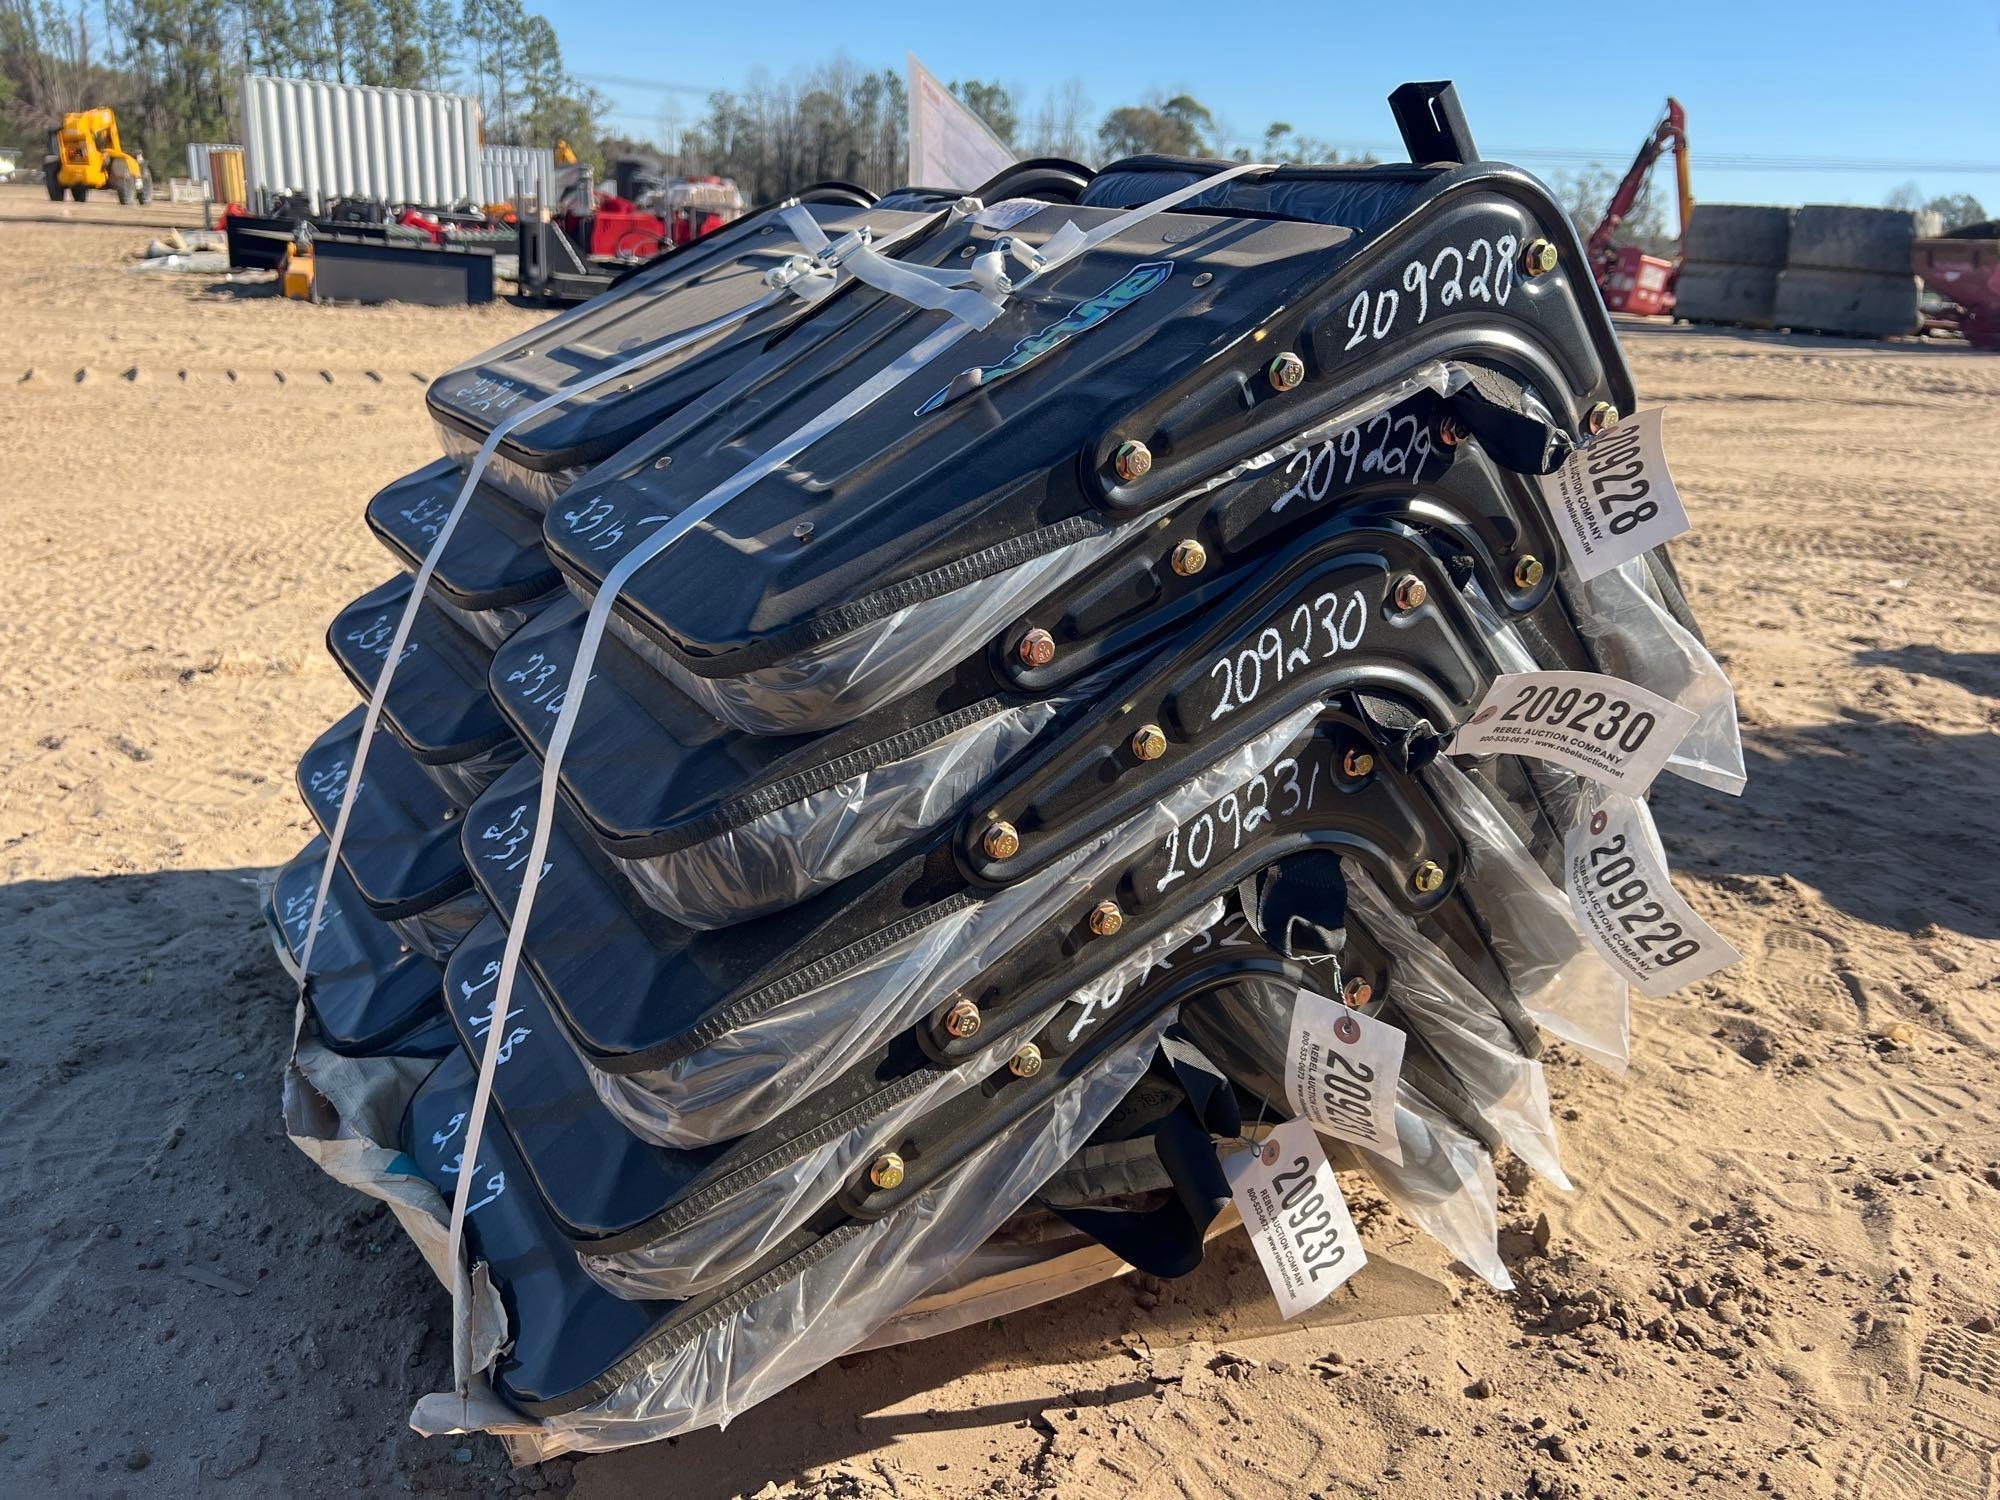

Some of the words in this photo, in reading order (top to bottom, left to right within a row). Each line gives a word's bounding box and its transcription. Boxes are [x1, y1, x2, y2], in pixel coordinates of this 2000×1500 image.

[1344, 234, 1518, 351] 209228
[1270, 411, 1432, 514] 209229
[1587, 425, 1659, 536] 209228
[1578, 496, 1603, 541] COMPANY
[1210, 590, 1368, 722] 209230
[1493, 726, 1523, 736] REBEL
[1524, 728, 1569, 743] AUCTION
[1570, 737, 1624, 765] COMPANY
[1500, 685, 1656, 753] 209230
[1534, 739, 1625, 779] www.rebelauction.net
[1156, 757, 1320, 893] 209231
[1580, 855, 1591, 889] REBEL
[1587, 890, 1614, 932] AUCTION
[1612, 933, 1653, 973] COMPANY
[1586, 909, 1650, 982] www.rebelauction.net
[1590, 834, 1701, 967] 209229
[1308, 1043, 1320, 1074] REBEL
[1259, 1188, 1273, 1217] REBEL
[1271, 1216, 1289, 1251] AUCTION
[1285, 1250, 1305, 1288] COMPANY
[1267, 1235, 1297, 1300] www.rebelauction.net
[1271, 1155, 1345, 1283] 209232
